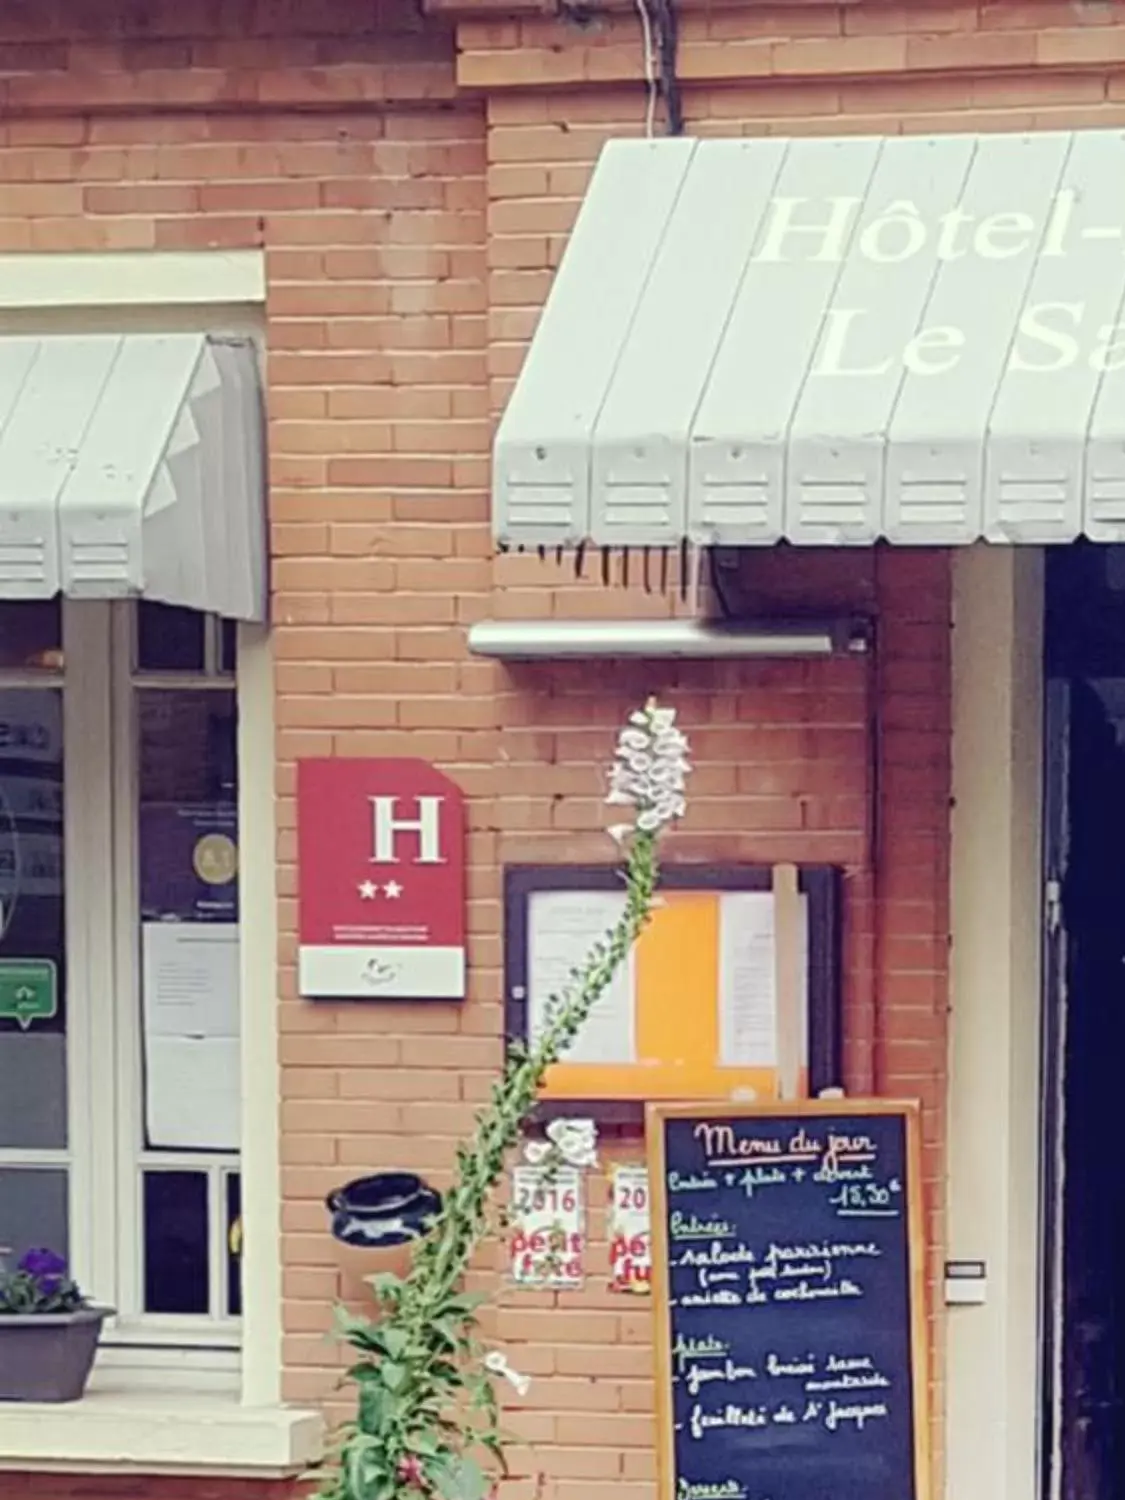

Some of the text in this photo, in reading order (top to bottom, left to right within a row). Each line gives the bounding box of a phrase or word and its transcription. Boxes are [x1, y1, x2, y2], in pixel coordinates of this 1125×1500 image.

[810, 308, 966, 376] Le
[367, 795, 448, 863] H
[694, 1122, 878, 1178] Menu du jour
[518, 1187, 576, 1213] 2016
